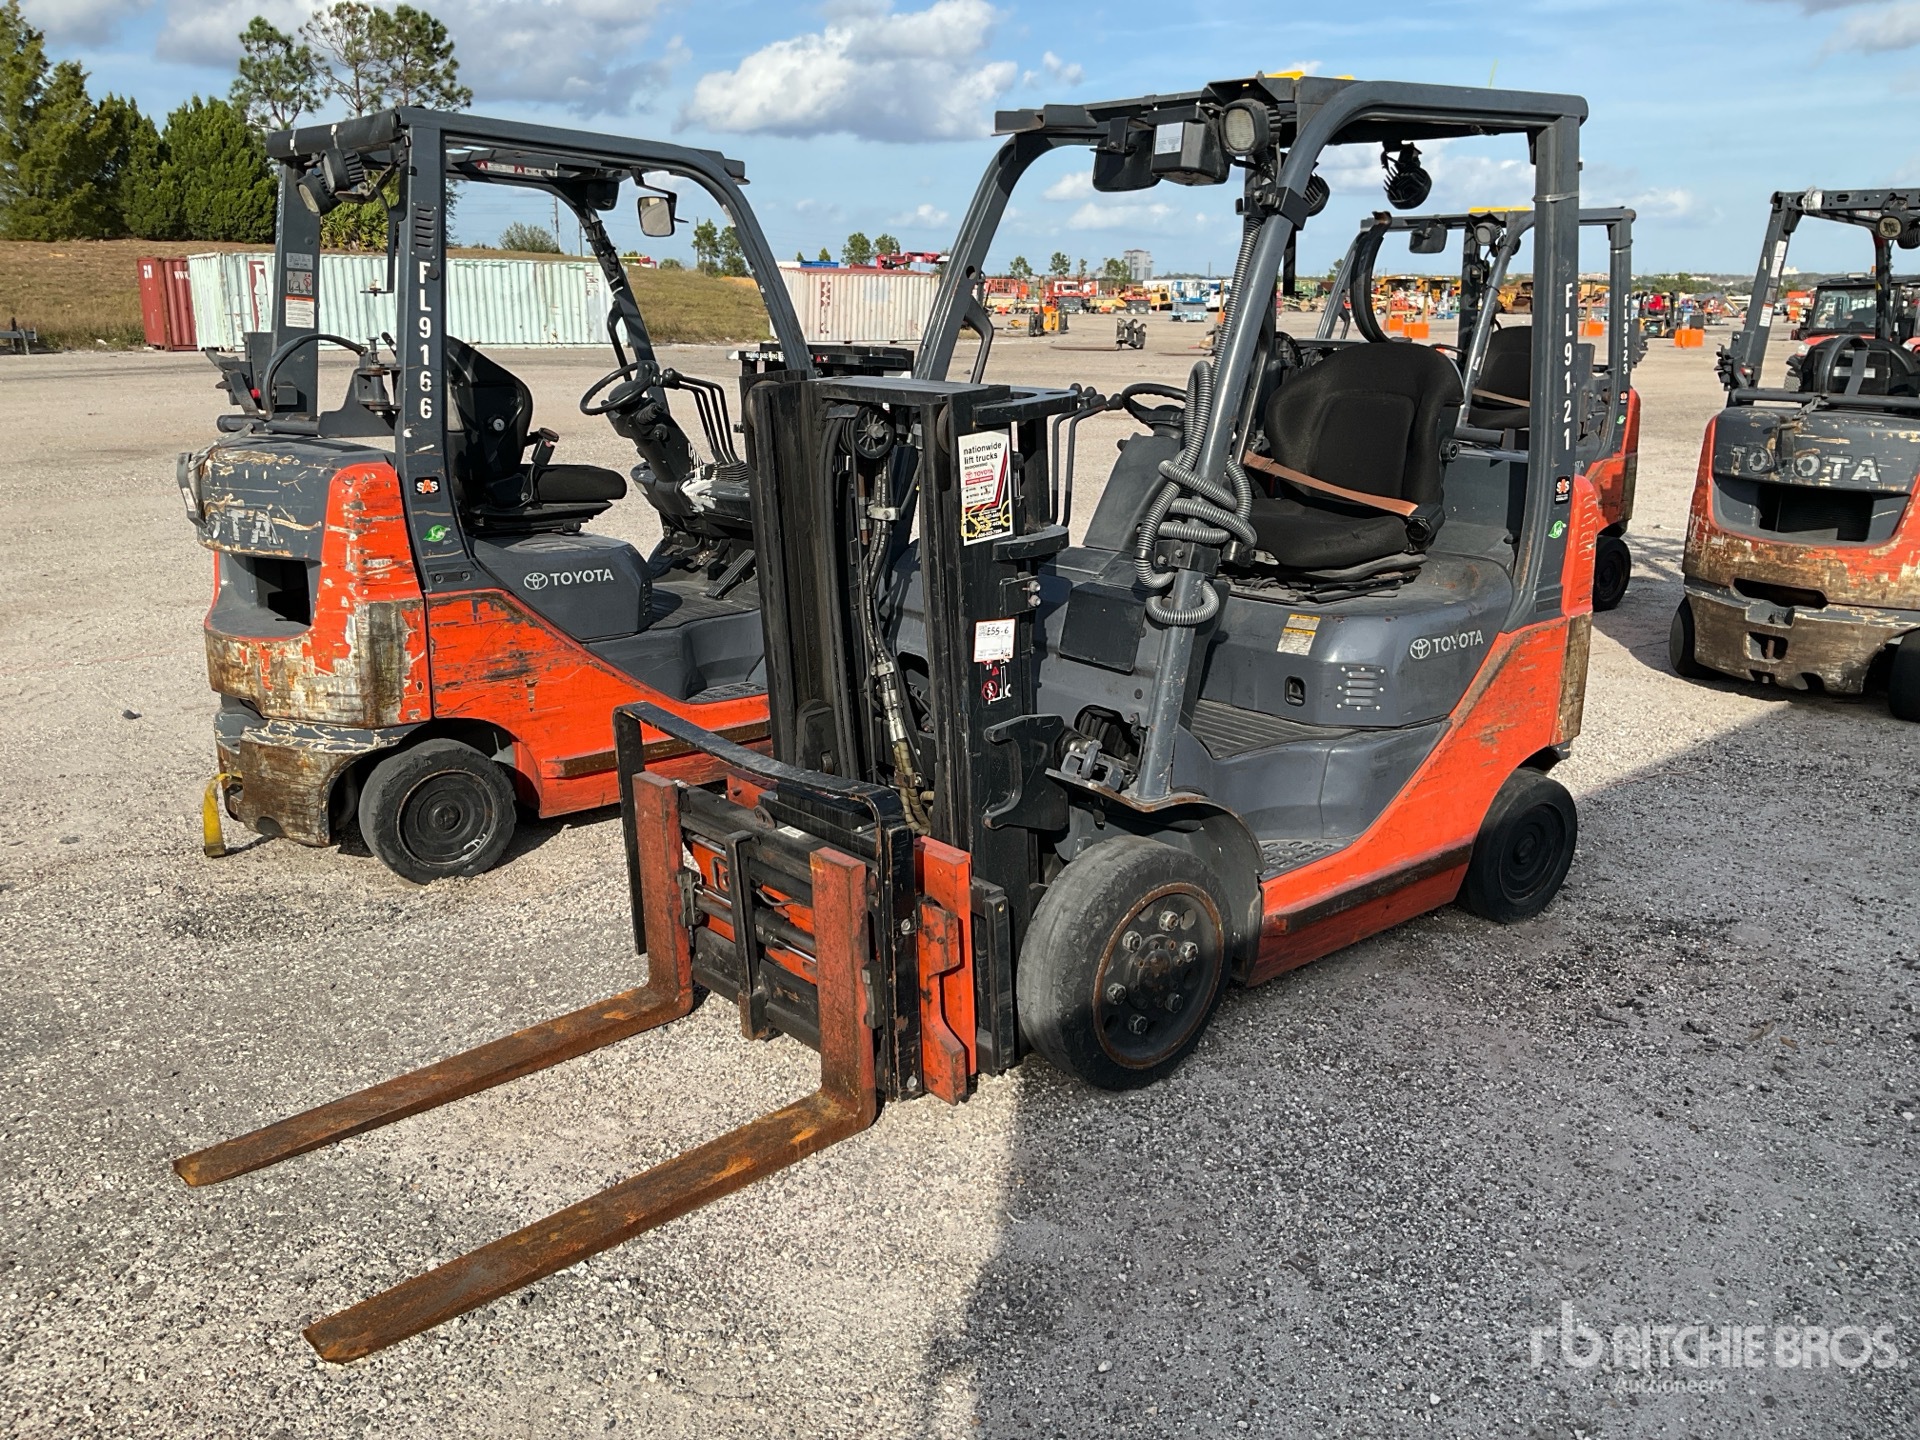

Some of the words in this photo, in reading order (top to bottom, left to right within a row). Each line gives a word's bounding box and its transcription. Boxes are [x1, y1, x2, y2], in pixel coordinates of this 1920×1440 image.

[419, 261, 432, 419] FL9166
[1622, 293, 1630, 375] FL9123
[1563, 282, 1573, 450] FL9121
[963, 442, 1002, 455] nationwide
[964, 456, 974, 465] lift
[975, 452, 998, 463] trucks
[973, 468, 994, 477] TOYOTA
[1731, 445, 1883, 483] TOOTA
[416, 479, 439, 494] SAS
[549, 568, 615, 586] TOYOTA
[1432, 629, 1484, 653] TOYOTA
